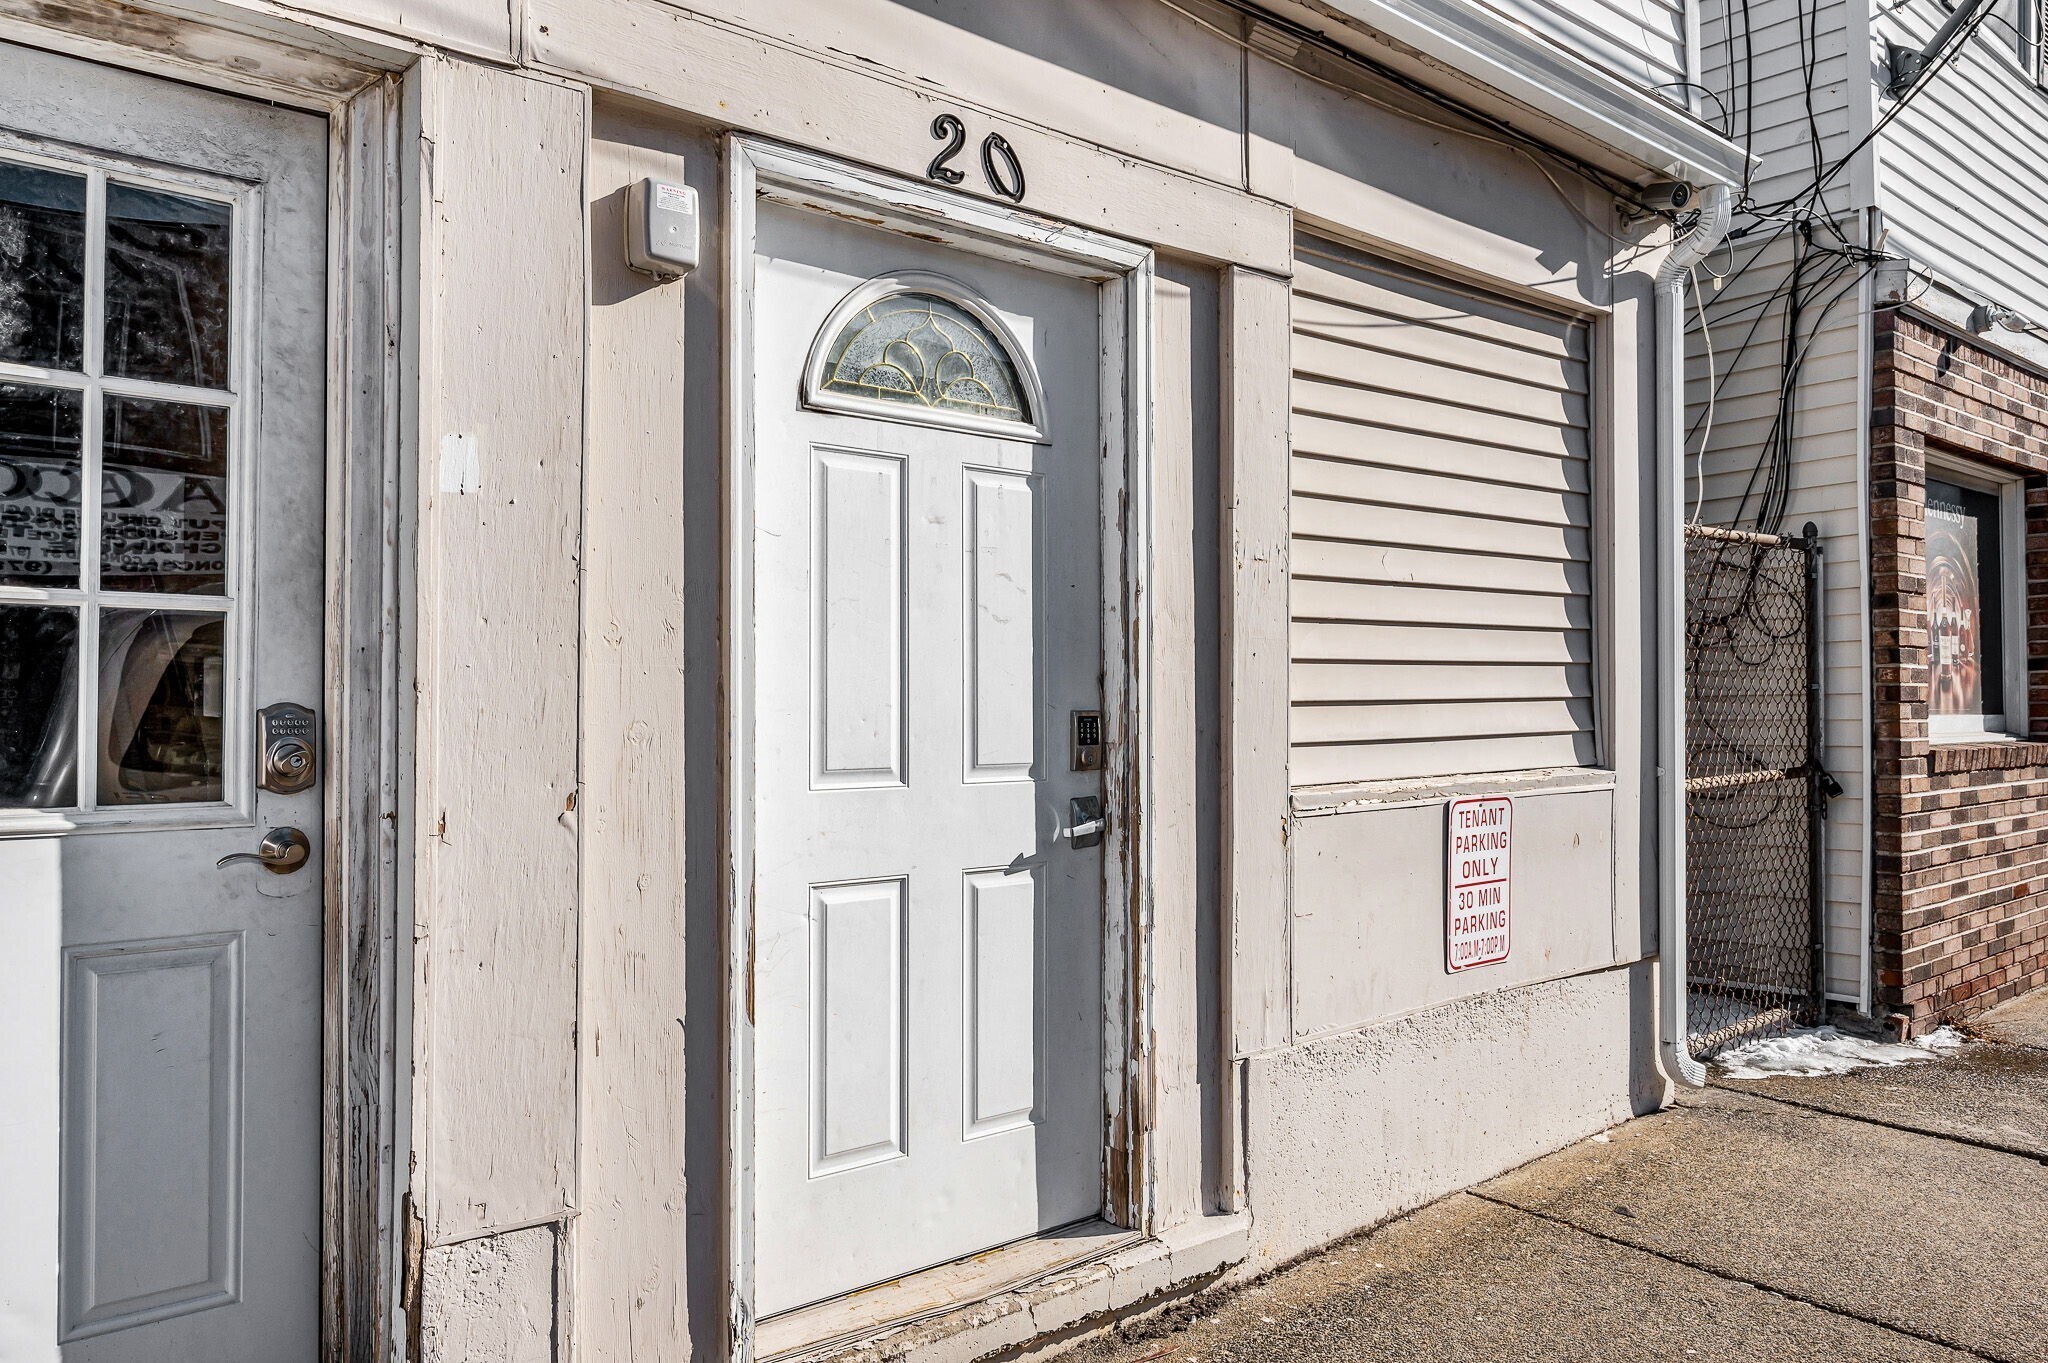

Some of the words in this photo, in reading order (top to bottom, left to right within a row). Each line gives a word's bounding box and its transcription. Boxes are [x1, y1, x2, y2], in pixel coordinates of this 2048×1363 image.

[926, 113, 1026, 203] 20
[1459, 807, 1505, 829] TENANT
[1456, 831, 1507, 855] PARKING
[1462, 857, 1498, 879] ONLY
[1459, 891, 1474, 910] 30
[1478, 886, 1501, 907] MIN
[1454, 910, 1506, 937] PARKING
